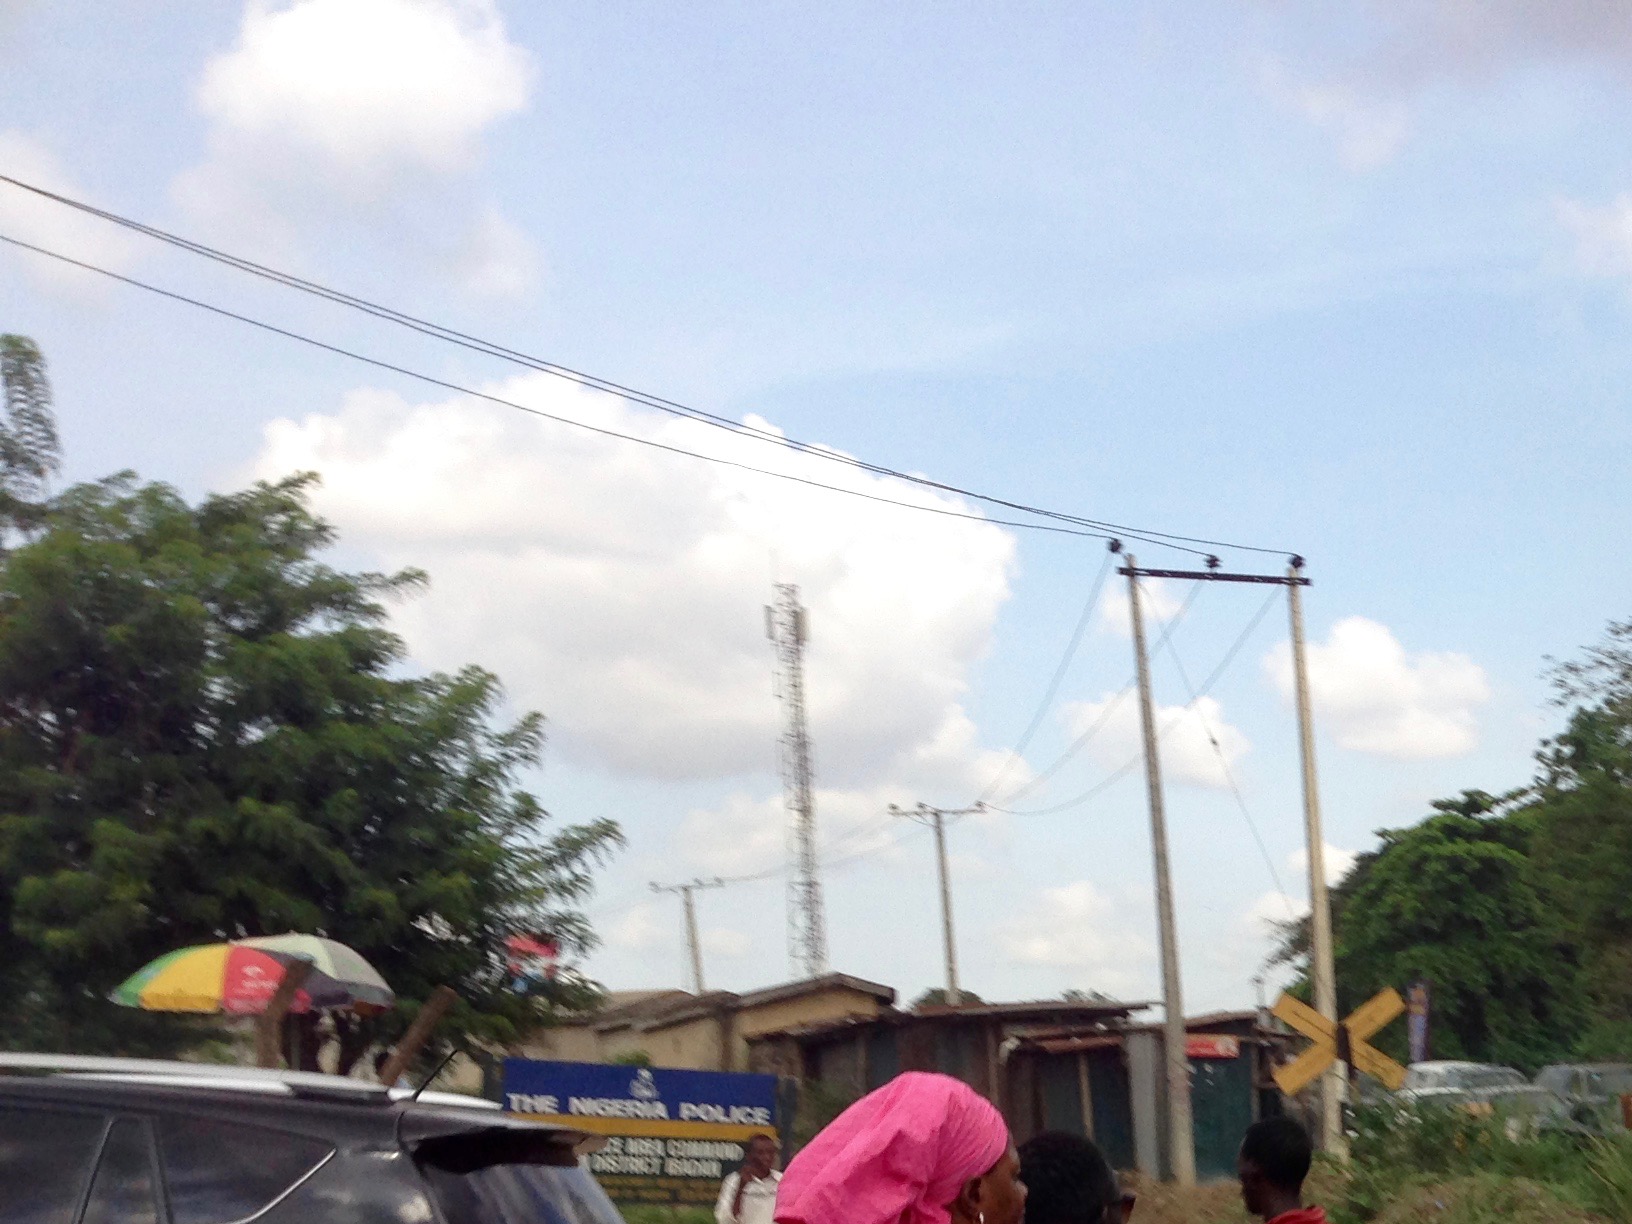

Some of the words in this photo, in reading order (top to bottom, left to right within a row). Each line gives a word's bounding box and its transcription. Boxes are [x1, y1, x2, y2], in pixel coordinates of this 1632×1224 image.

[506, 1093, 559, 1115] THE
[568, 1096, 670, 1120] NIGERIA
[678, 1102, 771, 1126] POLICE
